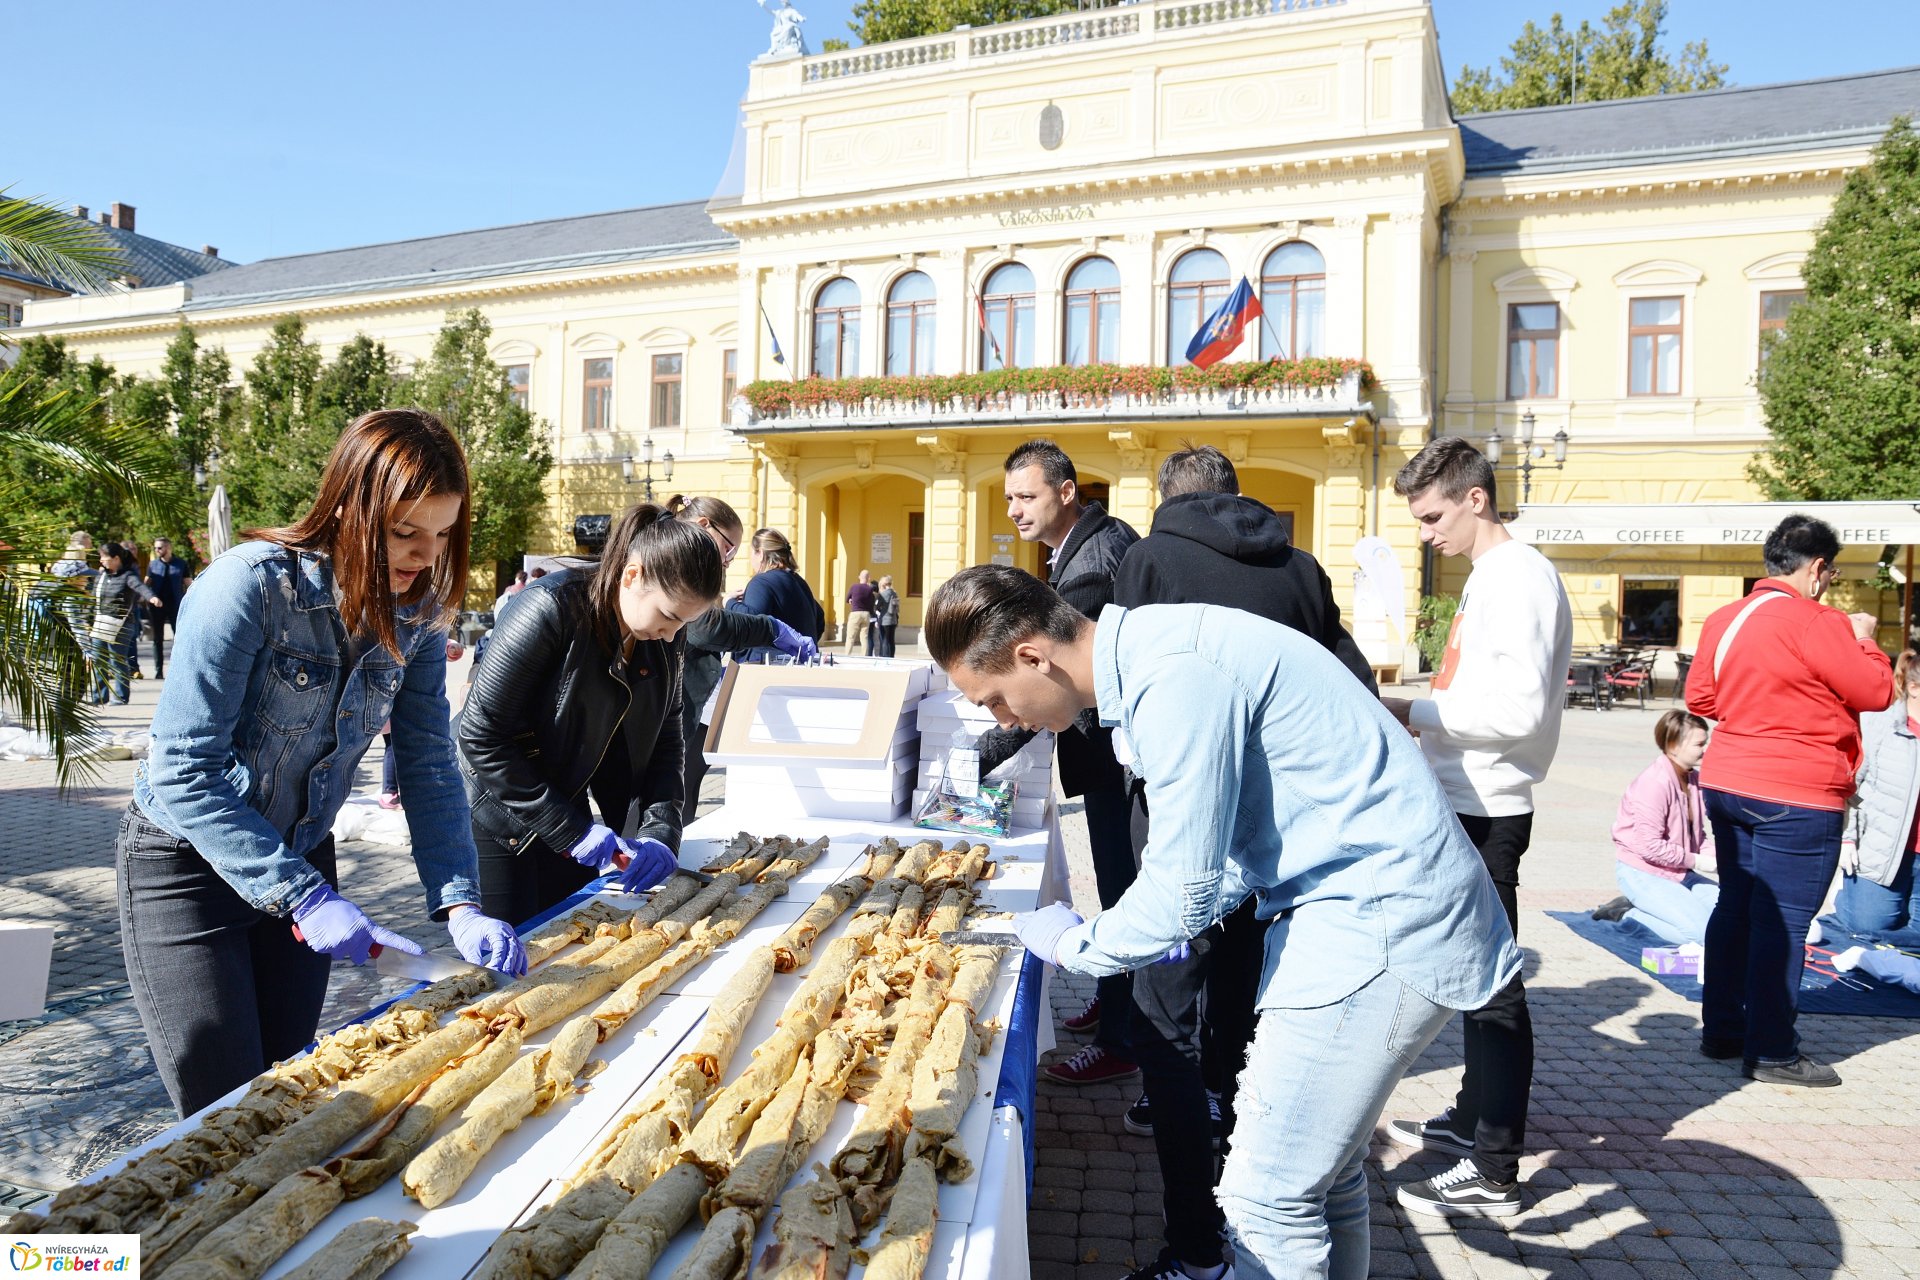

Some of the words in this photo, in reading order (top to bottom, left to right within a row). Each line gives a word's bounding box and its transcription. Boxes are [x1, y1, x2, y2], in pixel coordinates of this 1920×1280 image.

[1536, 529, 1584, 541] PIZZA
[1616, 530, 1685, 542] COFFEE
[1843, 529, 1890, 541] FFEE
